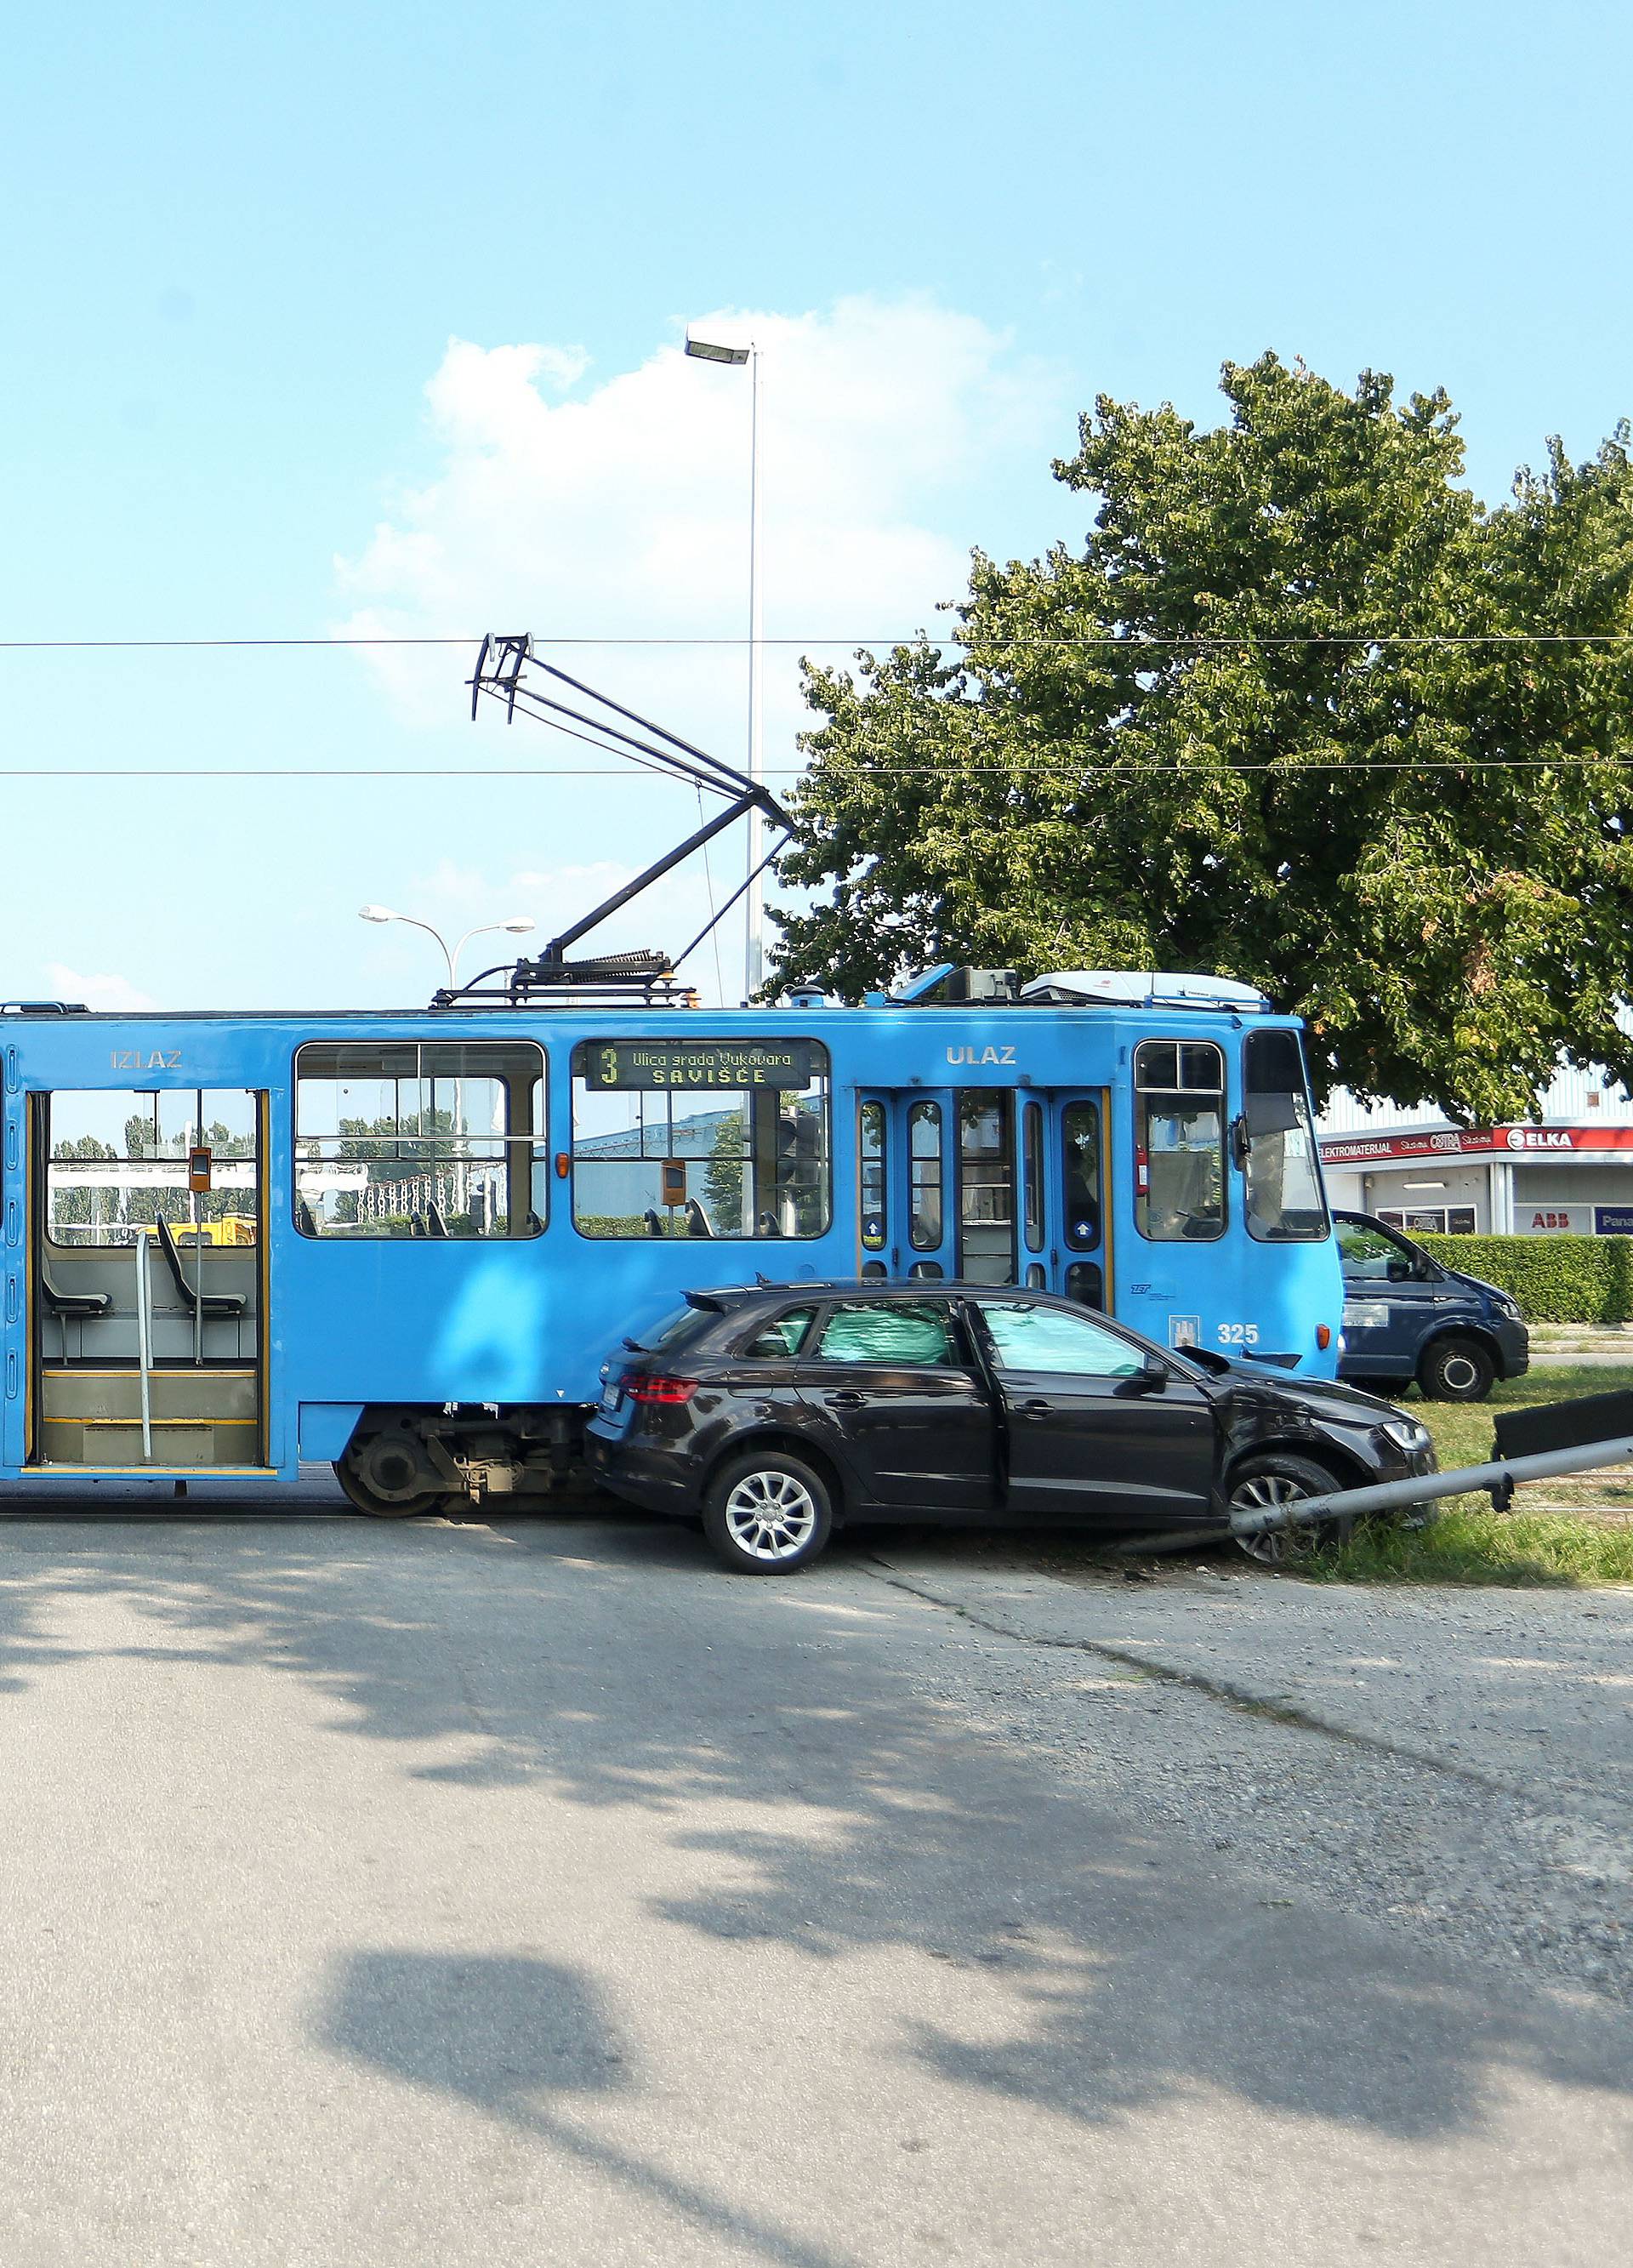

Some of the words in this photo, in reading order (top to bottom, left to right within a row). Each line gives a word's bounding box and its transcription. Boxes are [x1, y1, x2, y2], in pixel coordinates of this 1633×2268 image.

[111, 1049, 183, 1068] IZLAZ
[632, 1052, 667, 1066] Ulica
[719, 1052, 792, 1067] Vukovara
[946, 1046, 1016, 1065] ULAZ
[600, 1048, 618, 1084] 3
[1525, 1132, 1573, 1147] ELKA
[1531, 1211, 1570, 1228] ABB
[1216, 1324, 1260, 1344] 325
